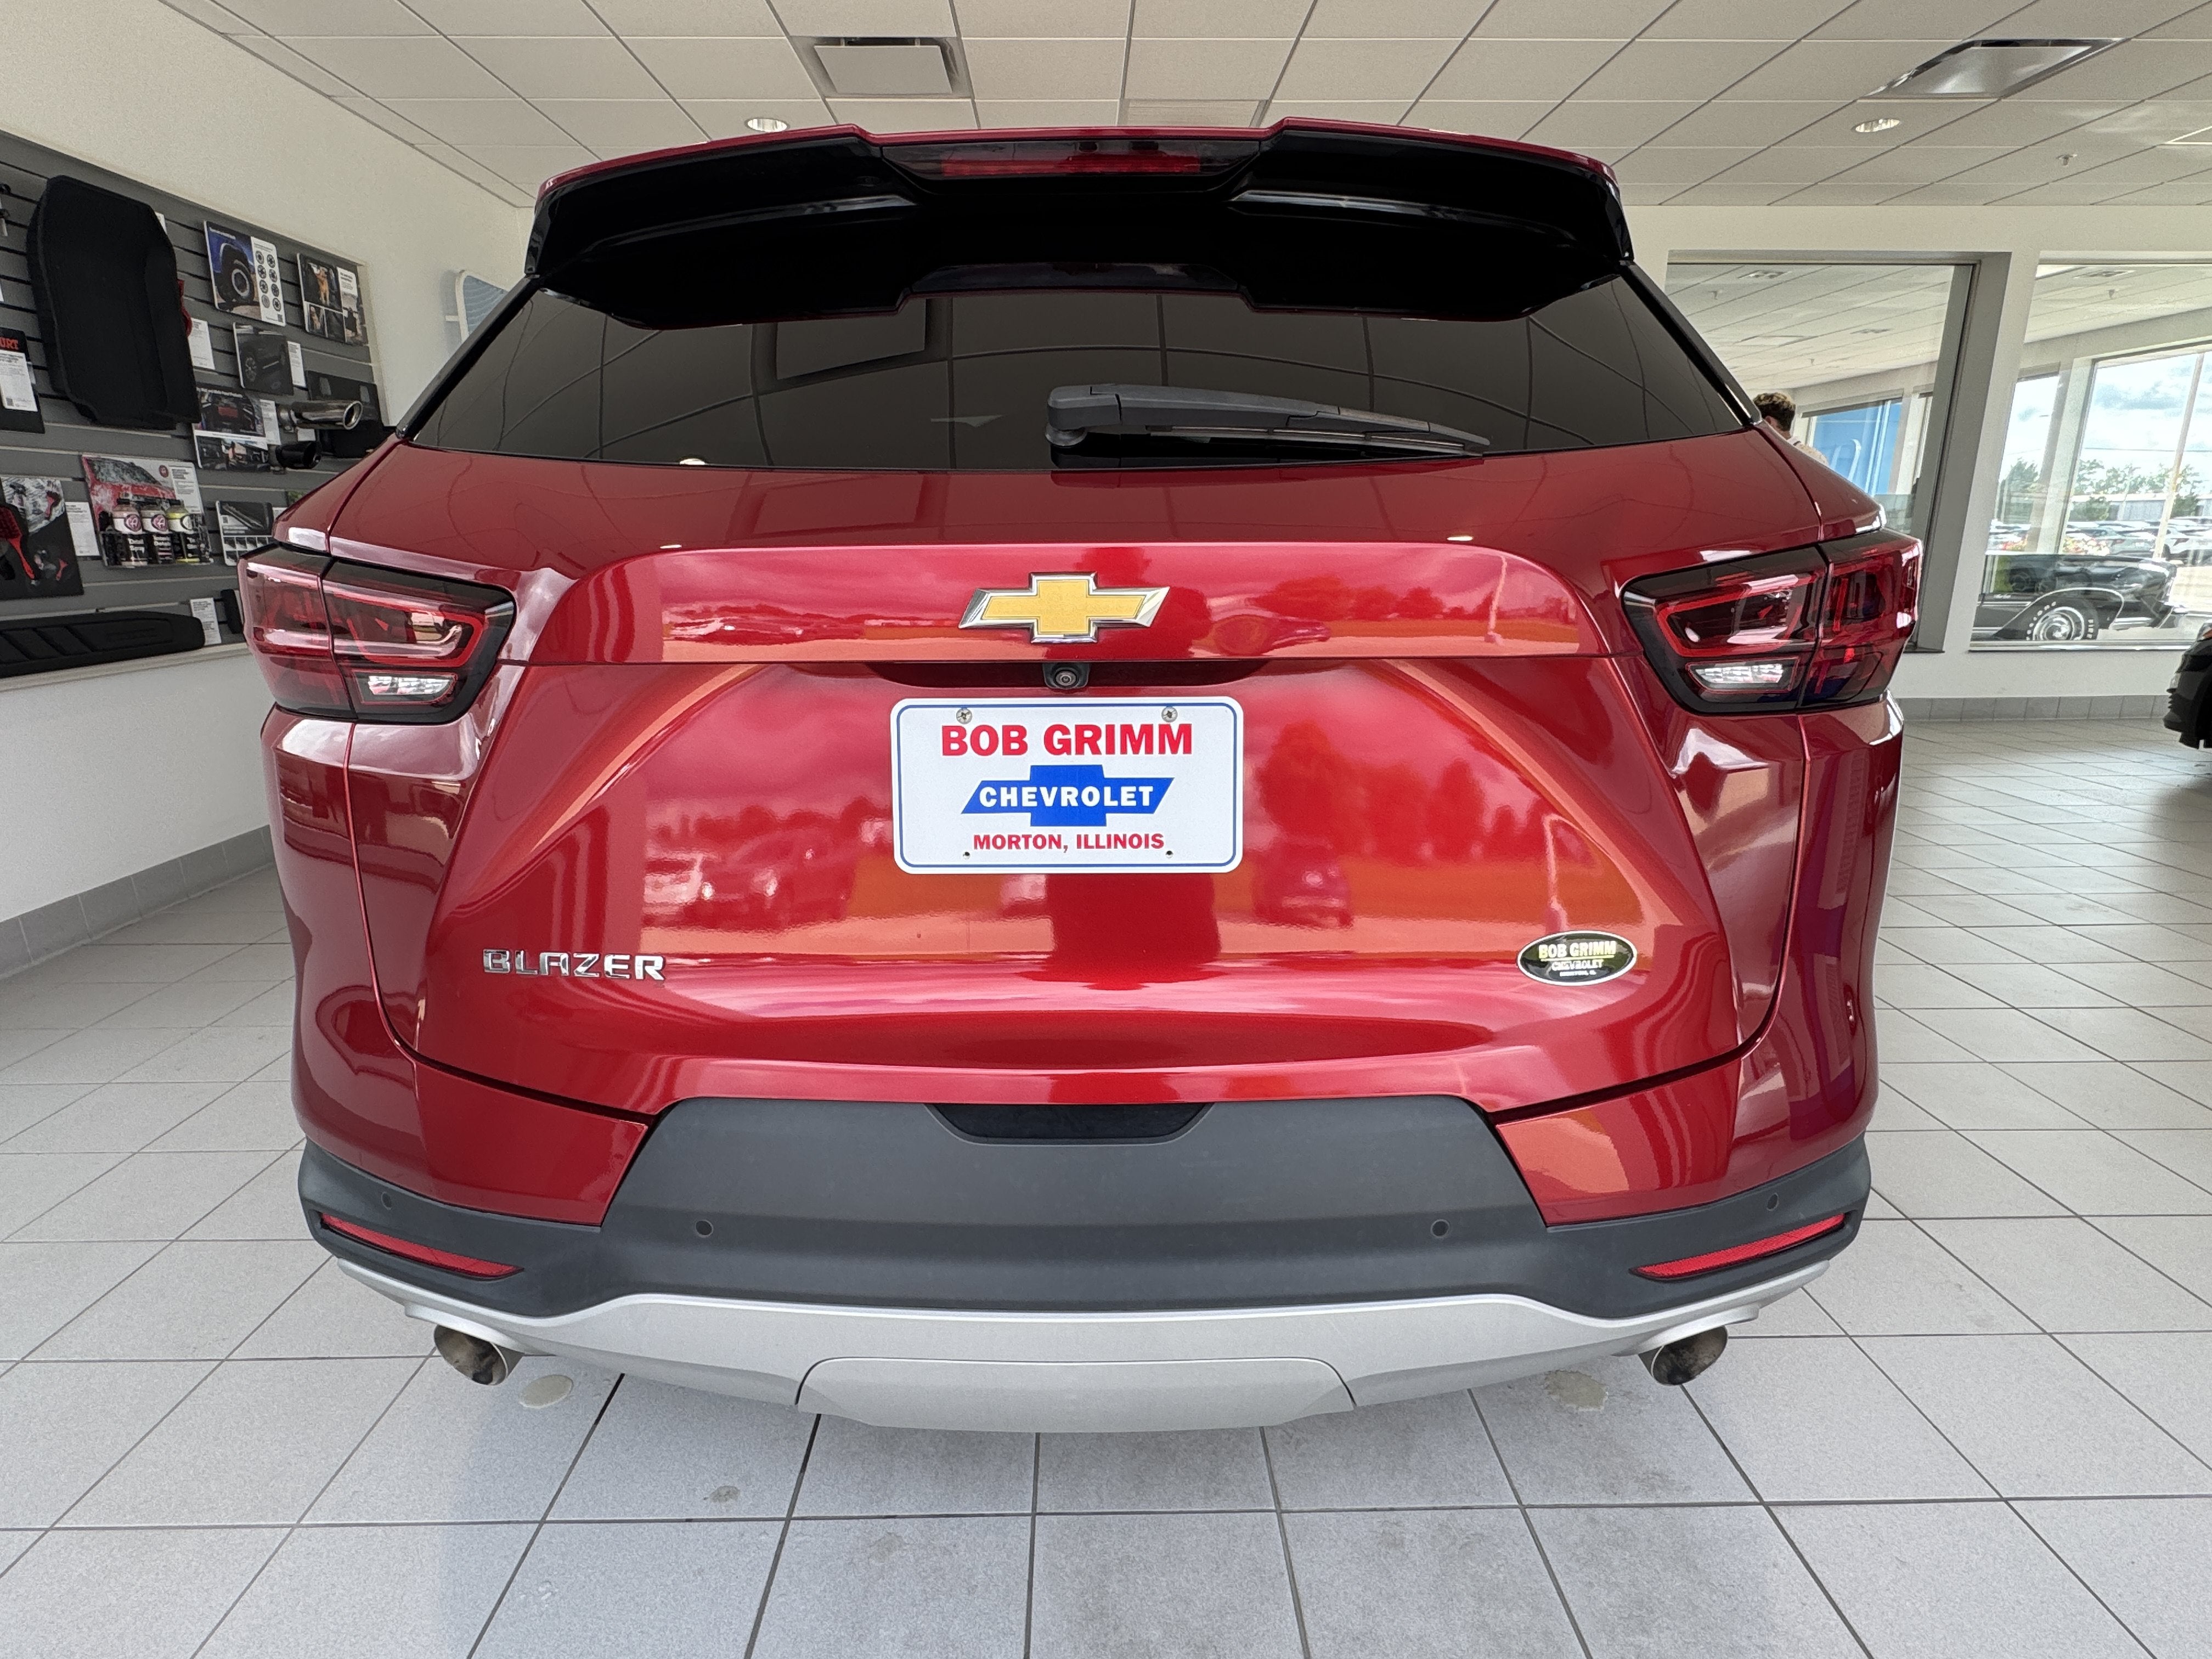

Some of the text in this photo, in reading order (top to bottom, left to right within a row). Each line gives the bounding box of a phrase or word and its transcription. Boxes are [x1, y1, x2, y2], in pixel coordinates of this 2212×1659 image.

[941, 723, 1193, 757] BOB GRIMM
[979, 786, 1154, 808] CHEVROLET
[973, 833, 1165, 853] MORTON, ILLINOIS
[1538, 940, 1616, 959] BOB GRIMM
[483, 949, 665, 981] BLAZER
[1551, 959, 1604, 971] CHEVROLET
